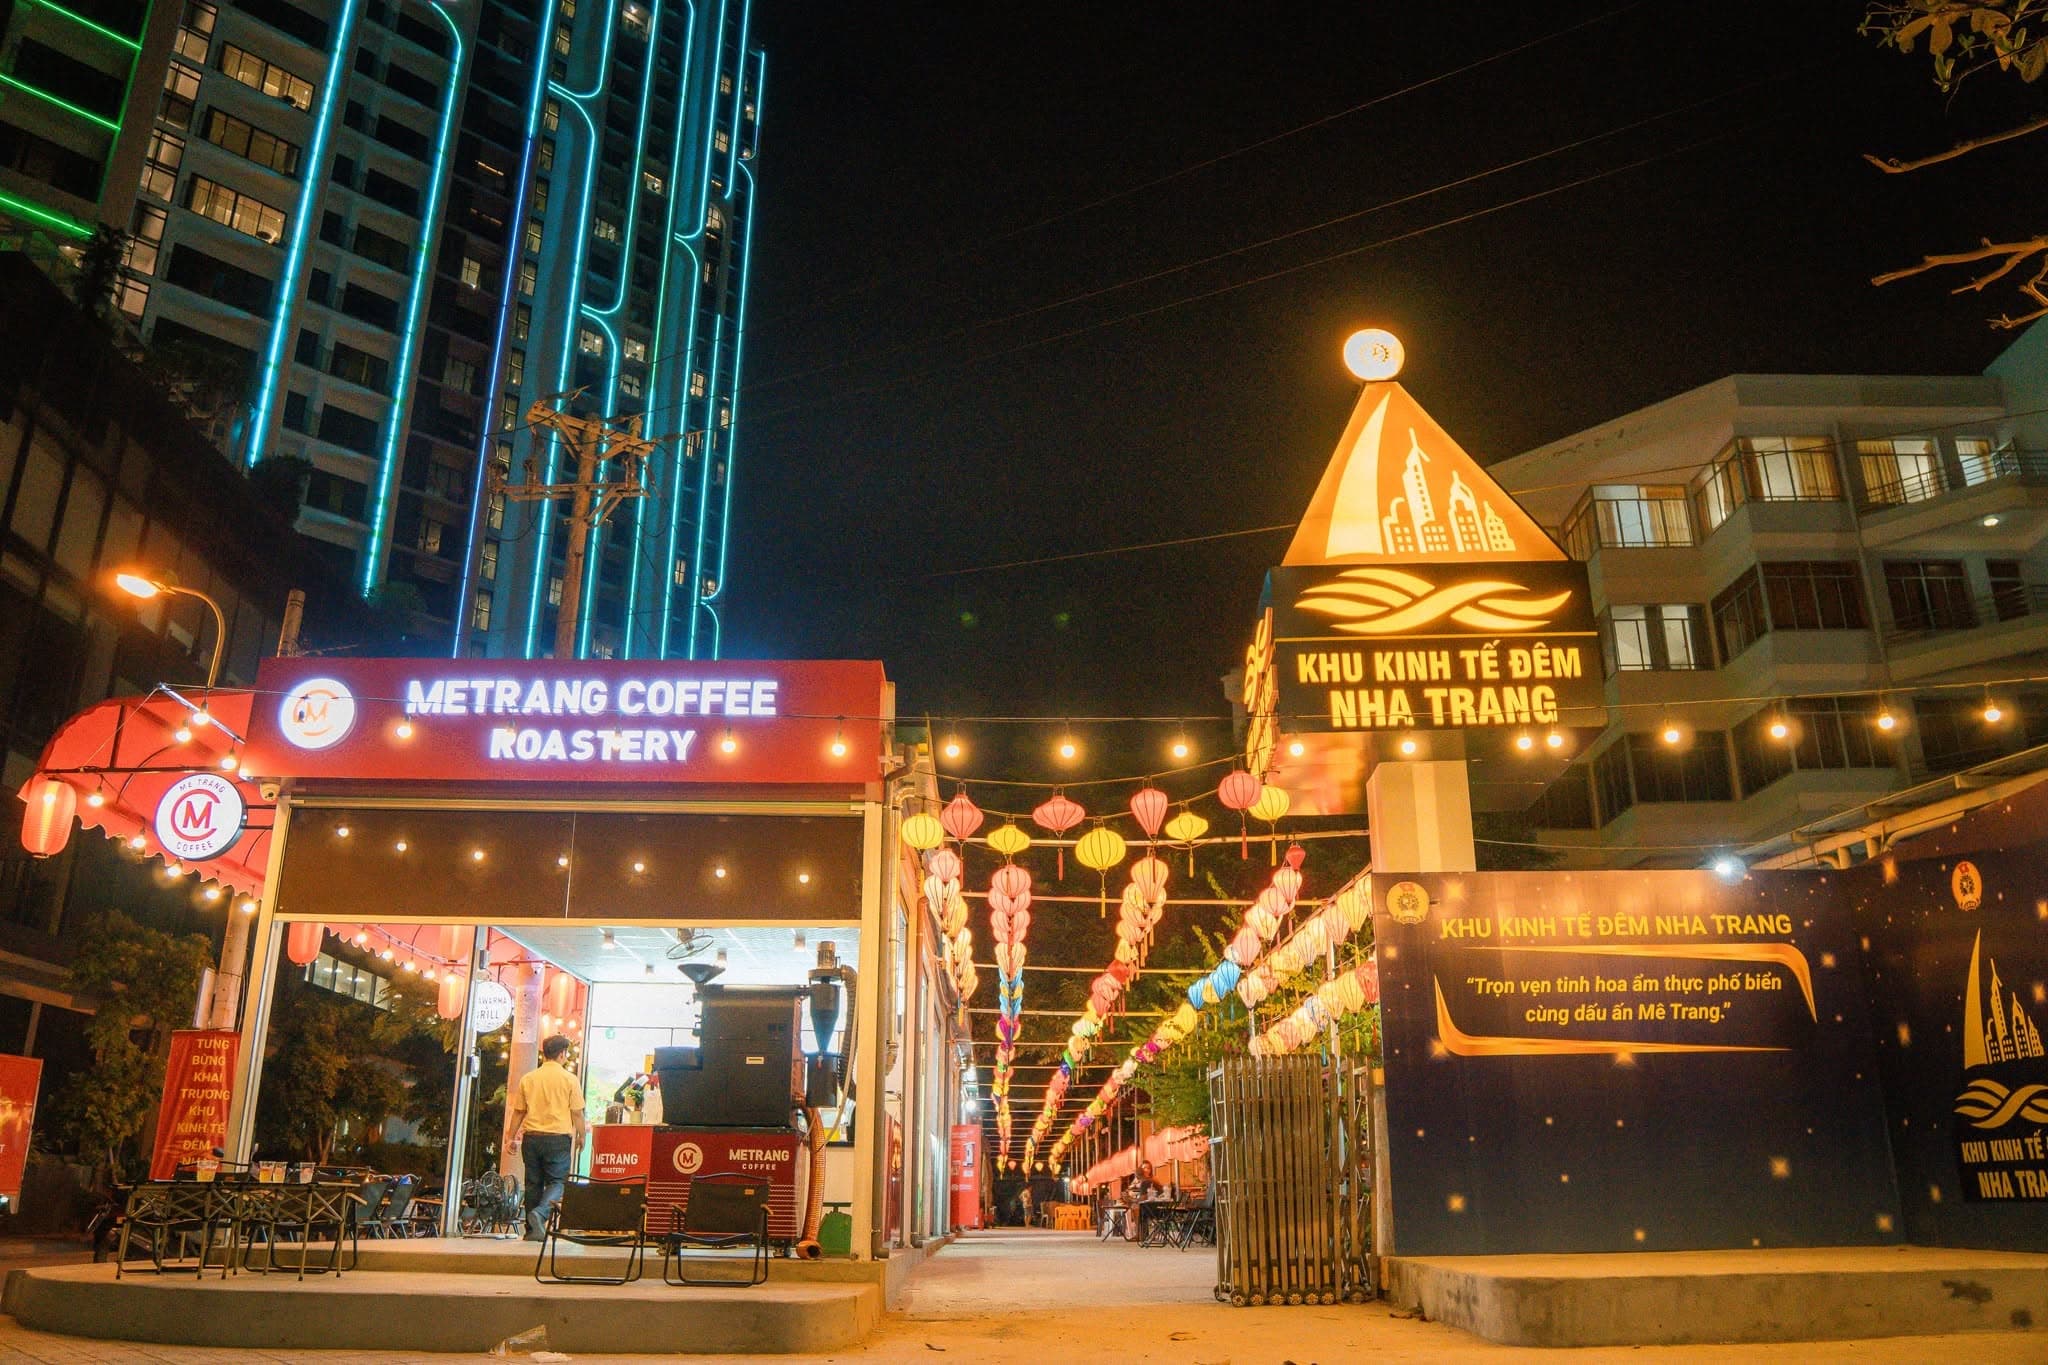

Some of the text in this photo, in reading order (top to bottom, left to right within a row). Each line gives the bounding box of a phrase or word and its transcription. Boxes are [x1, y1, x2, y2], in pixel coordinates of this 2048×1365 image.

[1298, 639, 1582, 683] KHU KINH TẾ ĐÊM
[406, 680, 778, 716] METRANG COFFEE
[1330, 685, 1559, 728] NHA TRANG
[489, 728, 697, 761] ROASTERY
[176, 840, 214, 852] COFFEE
[1441, 911, 1793, 938] KHU KINH TẾ ĐÊM NHA TRANG
[1520, 979, 1551, 997] vẹn
[1556, 975, 1590, 993] tinh
[1595, 975, 1628, 993] hoa
[1664, 973, 1704, 995] thực
[1708, 972, 1742, 995] phố
[1525, 1004, 1570, 1026] cùng
[1574, 1002, 1607, 1022] dấu
[1611, 1002, 1633, 1021] ấn
[1638, 1001, 1666, 1021] Mê
[193, 1072, 224, 1082] KHAI
[189, 1105, 216, 1117] KHU
[177, 1122, 207, 1133] KINH
[595, 1153, 639, 1165] METRANG
[729, 1149, 790, 1162] METRANG
[1961, 1129, 2046, 1164] KHU KINH TẾ
[742, 1163, 777, 1171] COFFEE
[1977, 1170, 2016, 1199] NHA
